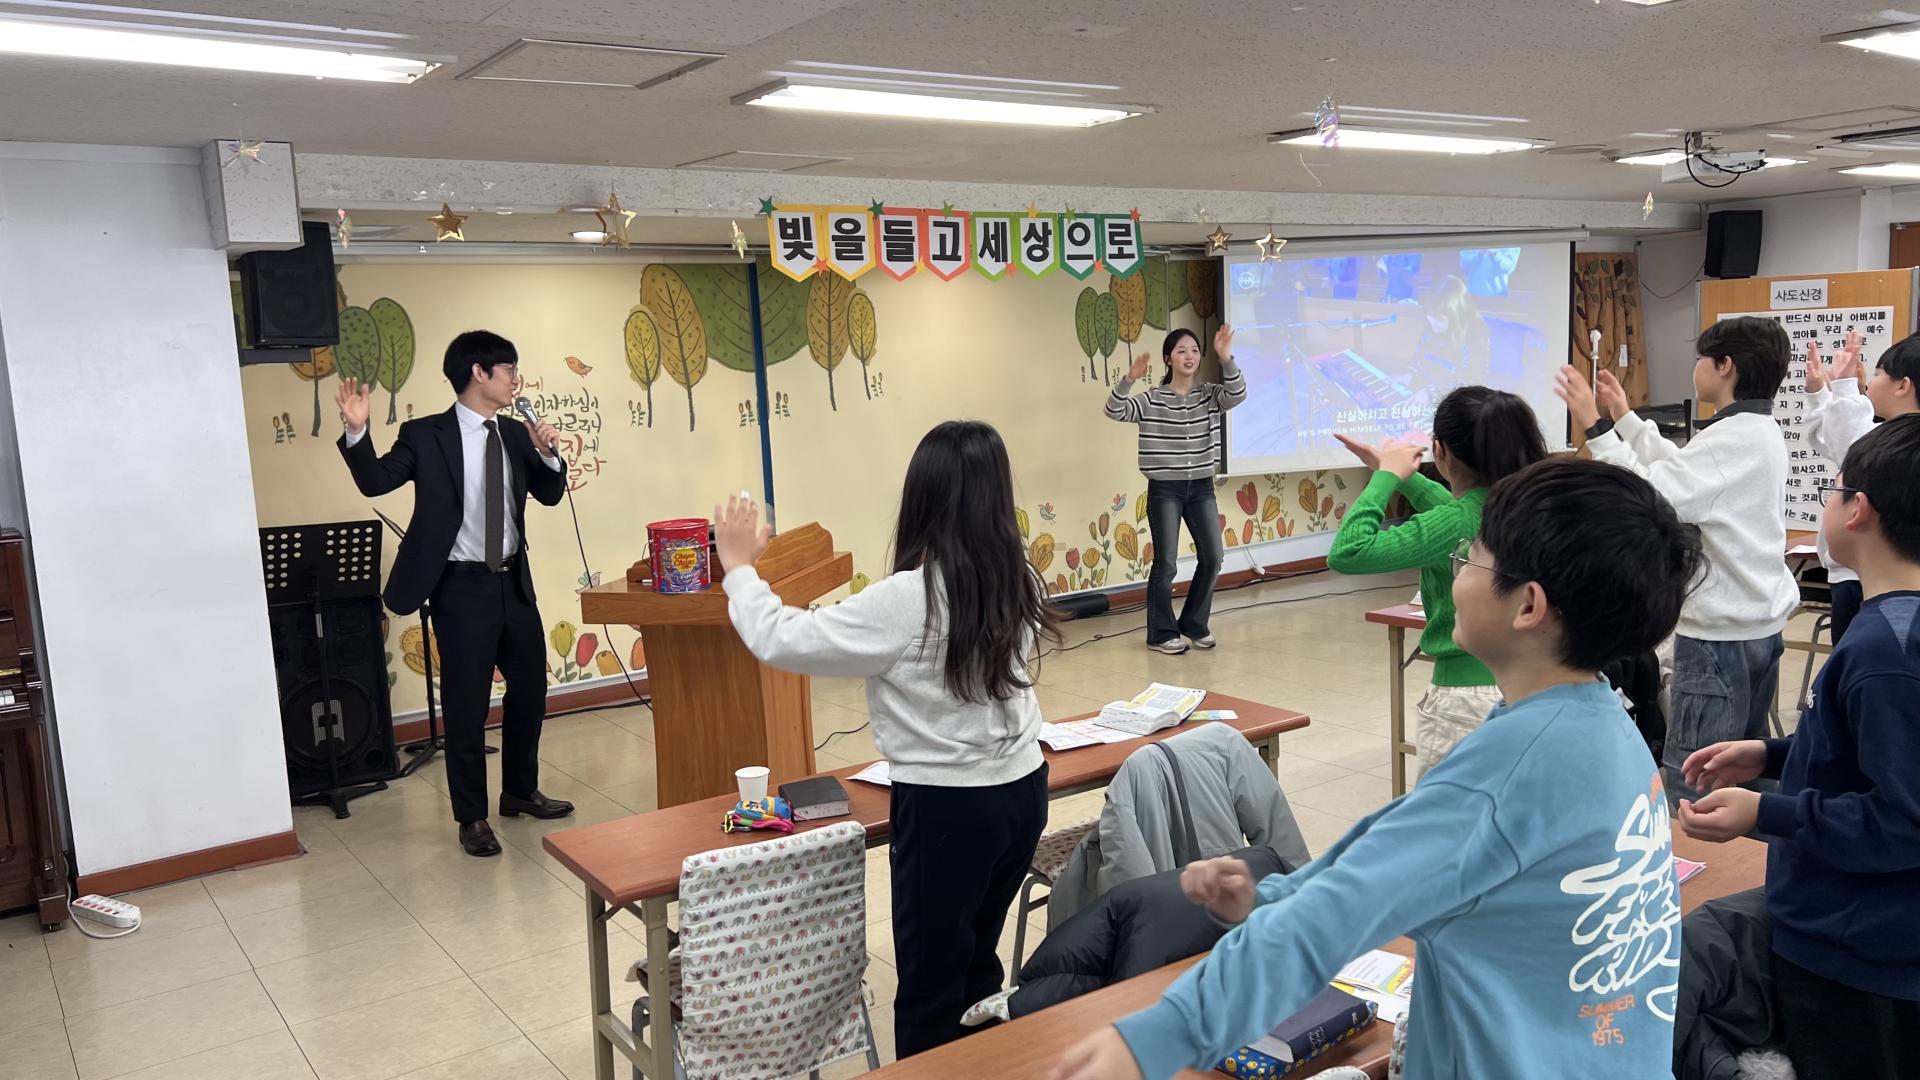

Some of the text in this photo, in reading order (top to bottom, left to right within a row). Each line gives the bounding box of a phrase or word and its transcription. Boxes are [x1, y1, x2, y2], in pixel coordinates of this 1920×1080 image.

[1775, 287, 1822, 302] 사도신경
[1785, 313, 1811, 324] 만드신
[1816, 313, 1843, 323] 하나님
[1850, 311, 1886, 322] 아버지를
[1824, 325, 1841, 334] 우리
[1866, 325, 1885, 334] 예수
[534, 387, 599, 418] 인자하심이
